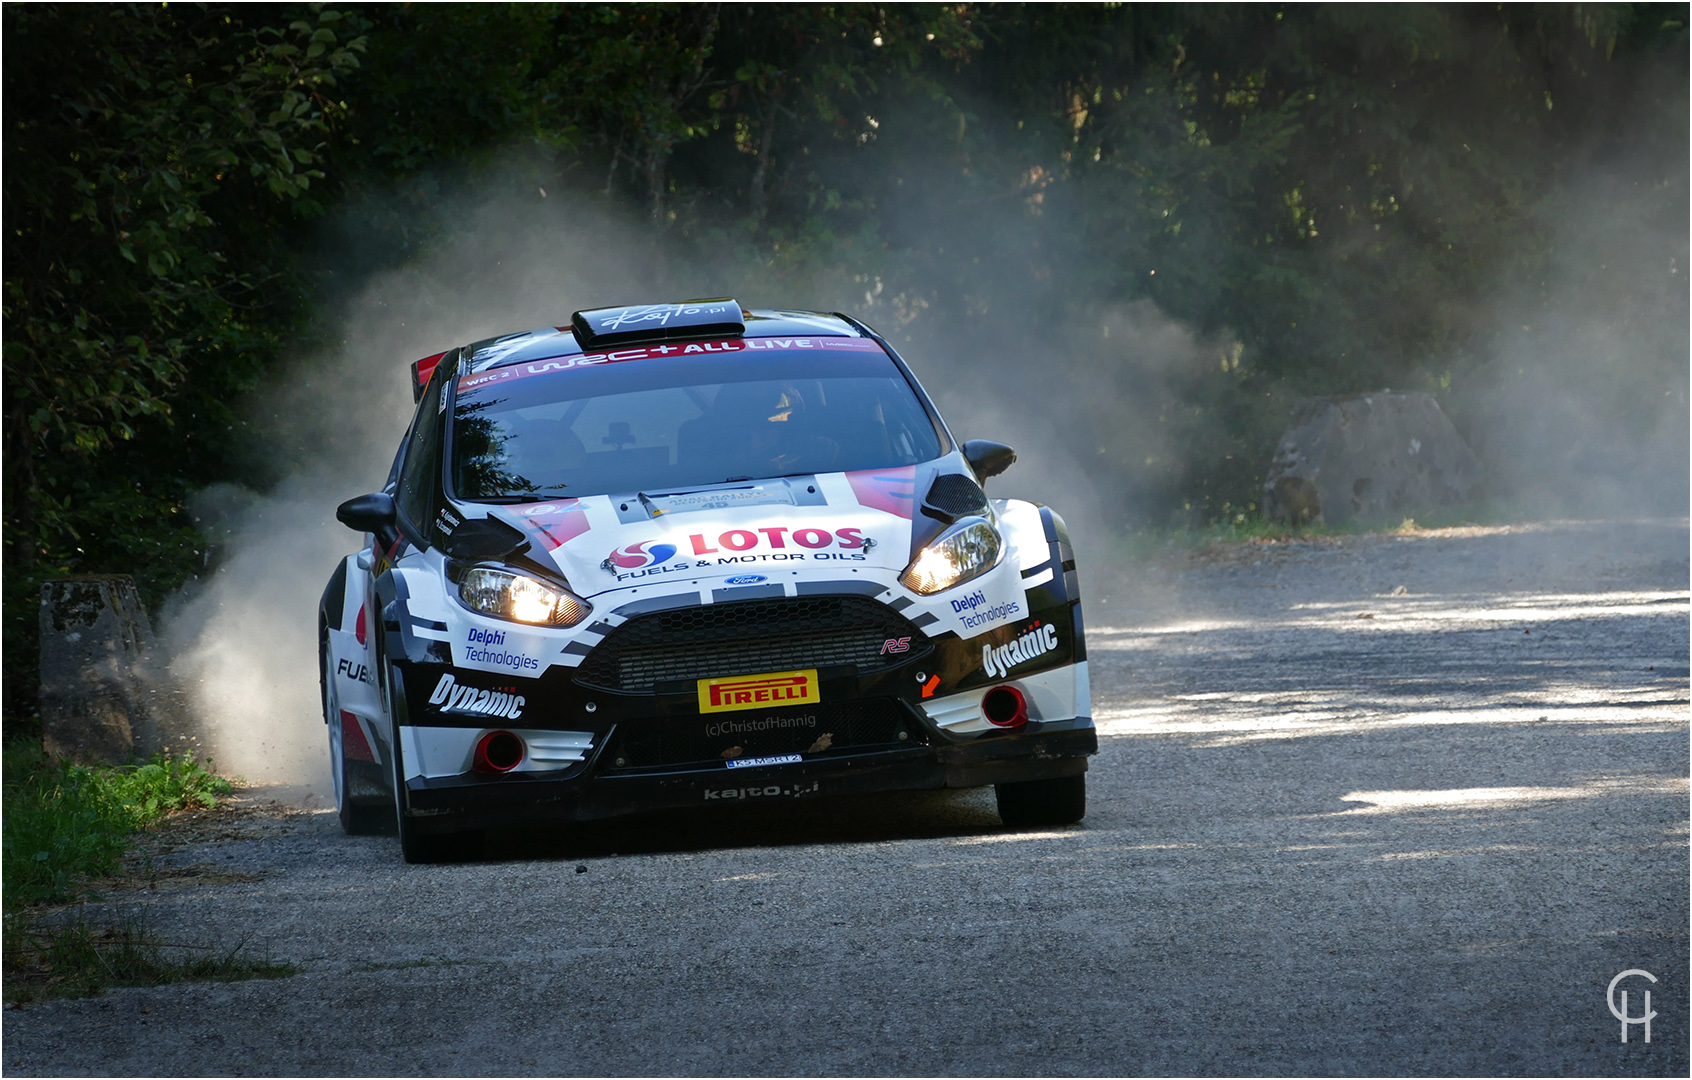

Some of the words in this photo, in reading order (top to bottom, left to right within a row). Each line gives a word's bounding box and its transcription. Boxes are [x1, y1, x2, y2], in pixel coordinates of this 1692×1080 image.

[466, 374, 498, 387] WRC
[501, 371, 510, 379] 2
[683, 341, 740, 354] ALL
[746, 339, 814, 350] LIVE
[688, 527, 865, 556] LOTOS
[616, 561, 690, 582] FUELS
[695, 559, 713, 568] &
[717, 552, 806, 566] MOTOR
[813, 552, 867, 562] OILS
[950, 589, 987, 614] Delphi
[959, 601, 1020, 630] Technologies
[467, 627, 506, 647] Delphi
[880, 636, 912, 656] RS
[982, 622, 1059, 679] Dynamic
[465, 645, 539, 670] Technologies
[428, 672, 527, 720] Dynamic
[708, 675, 809, 707] PIRELLI
